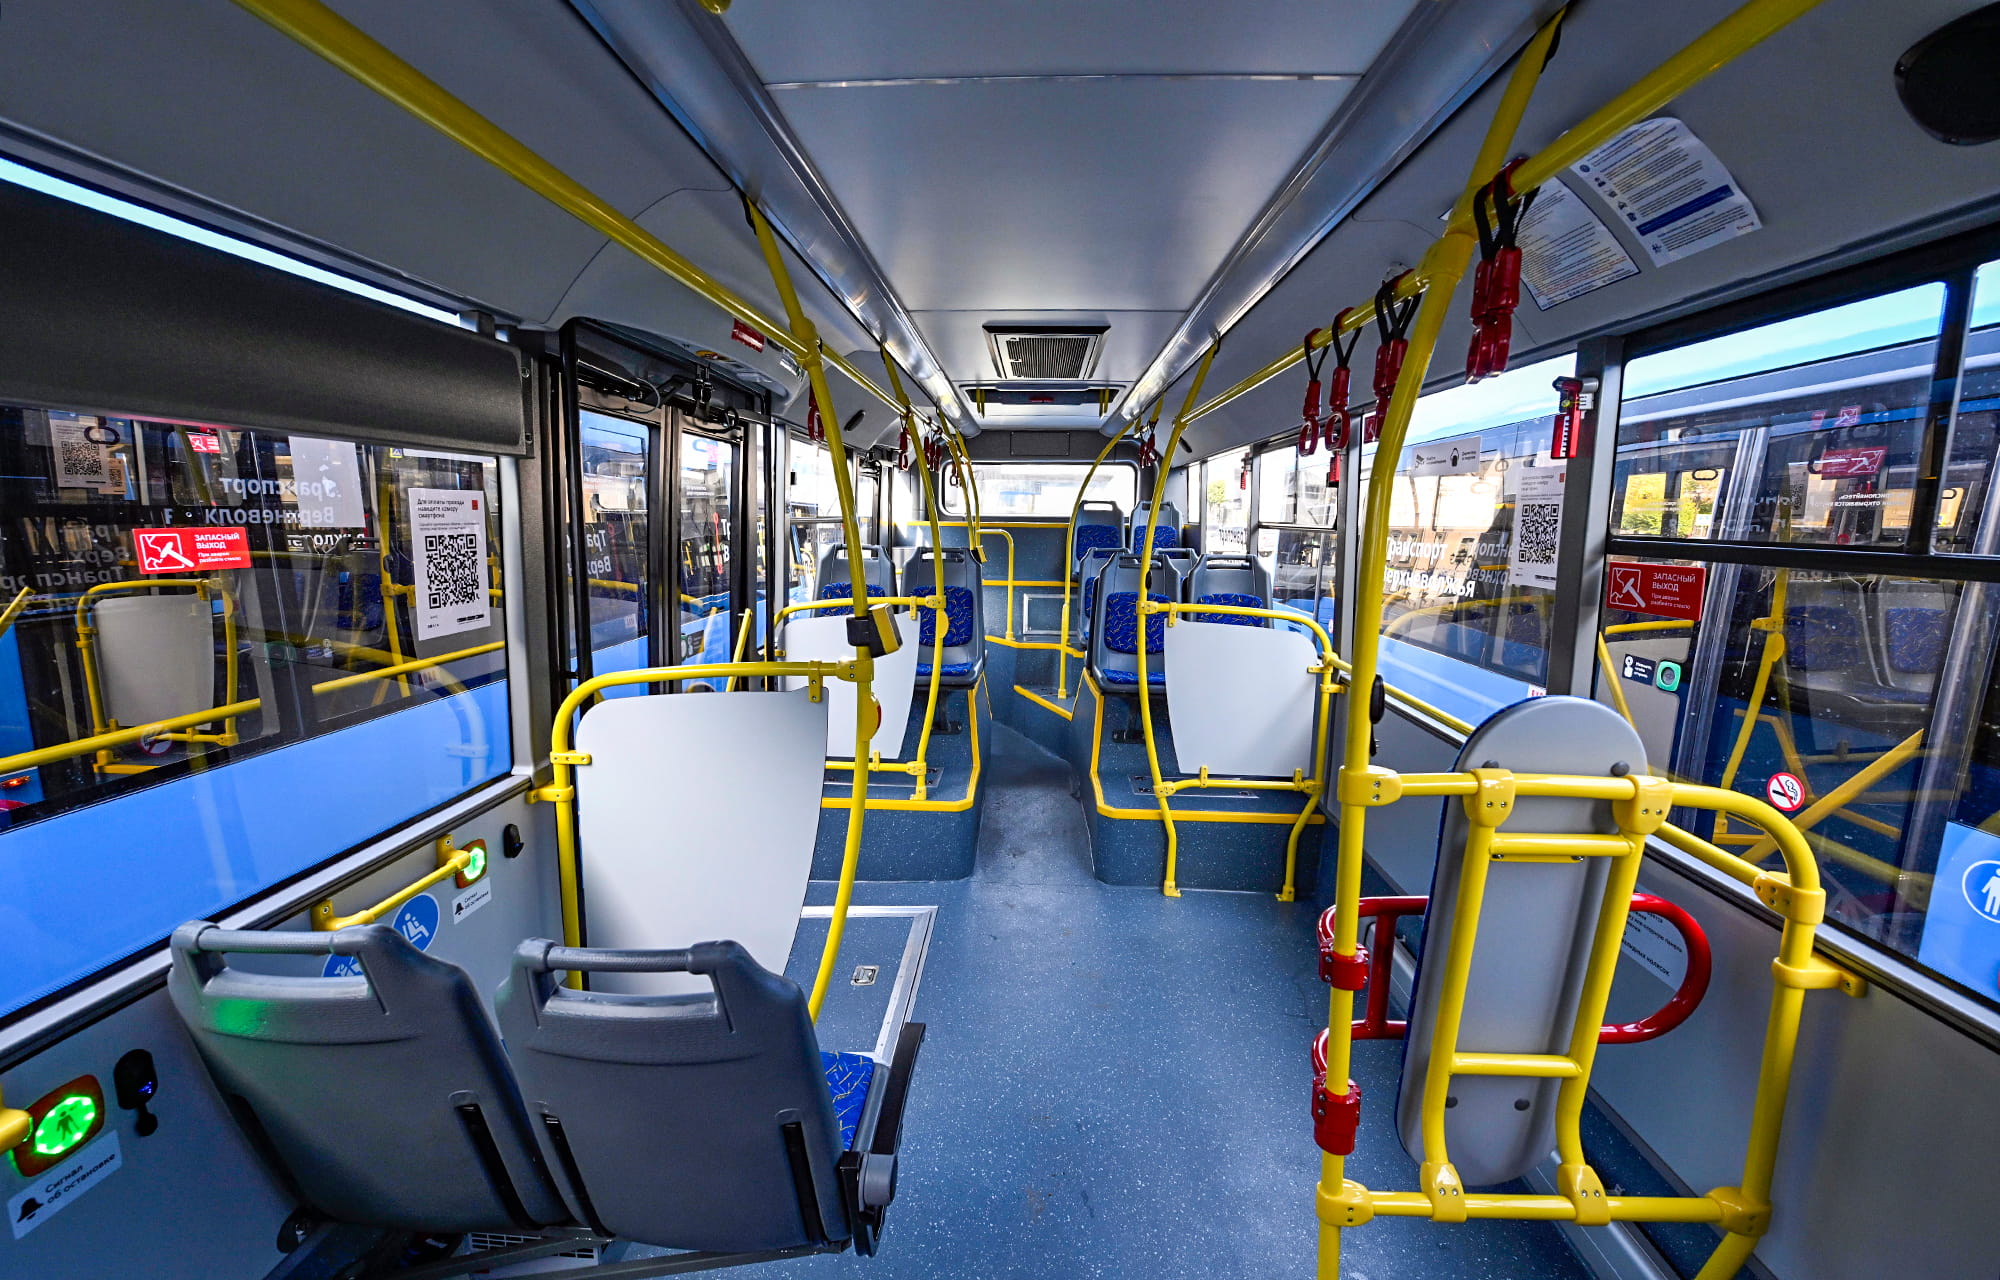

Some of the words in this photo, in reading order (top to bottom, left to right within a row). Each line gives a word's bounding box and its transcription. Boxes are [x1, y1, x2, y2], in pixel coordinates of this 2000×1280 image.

[194, 532, 240, 541] ЗАПАСНЫЙ
[195, 541, 227, 550] ВЫХОД
[1653, 572, 1696, 583] ЗАПАСНЫЙ
[1652, 581, 1679, 592] ВЫХОД
[45, 1165, 83, 1193] Сигнал
[47, 1189, 62, 1204] об
[63, 1153, 116, 1192] остановке
